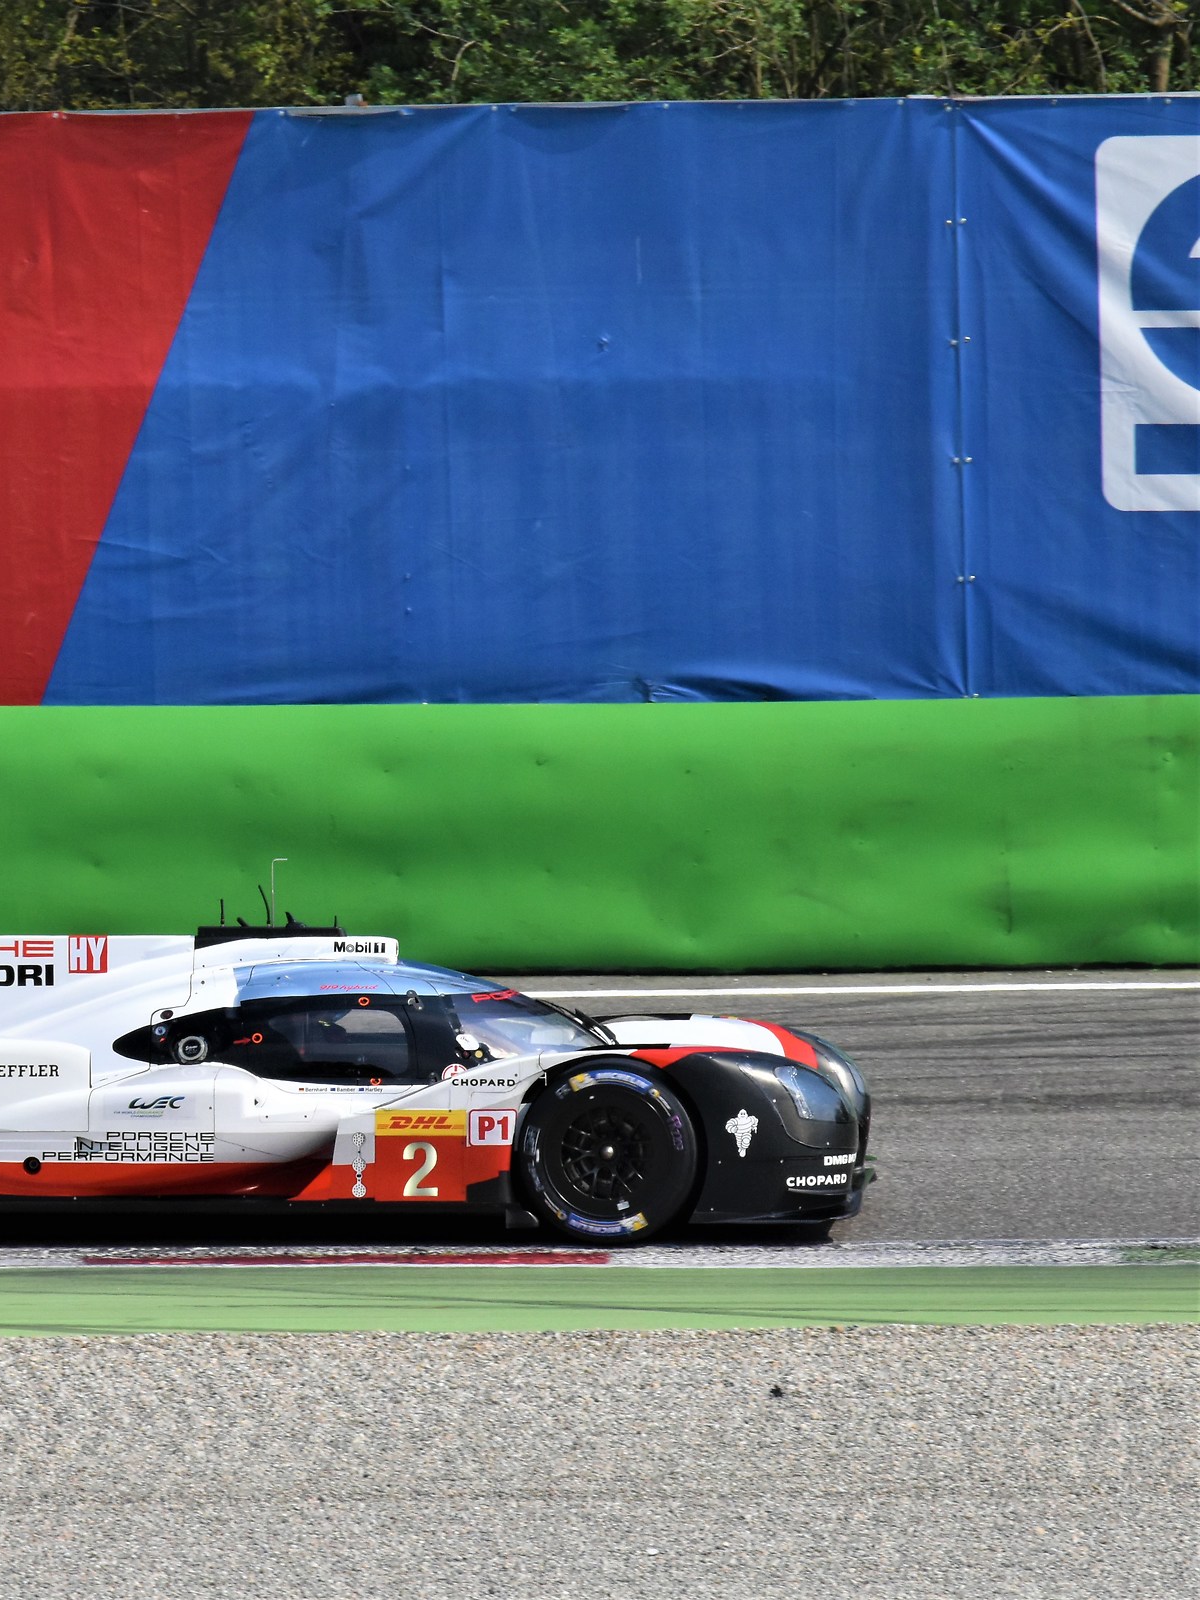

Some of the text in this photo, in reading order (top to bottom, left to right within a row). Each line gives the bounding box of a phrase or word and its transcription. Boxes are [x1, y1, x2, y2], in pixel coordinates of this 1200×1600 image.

[333, 941, 371, 953] Mobil
[70, 938, 104, 971] HY
[451, 1078, 516, 1087] CHOPARD
[128, 1095, 186, 1109] WEC
[389, 1116, 452, 1130] DHL
[478, 1116, 509, 1141] P1
[106, 1132, 215, 1142] PORSCHE
[74, 1142, 215, 1152] INTELLIGENT
[42, 1152, 215, 1162] PERFORMANCE
[823, 1154, 848, 1167] DMG
[402, 1141, 439, 1197] 2
[786, 1174, 848, 1187] CHOPARD
